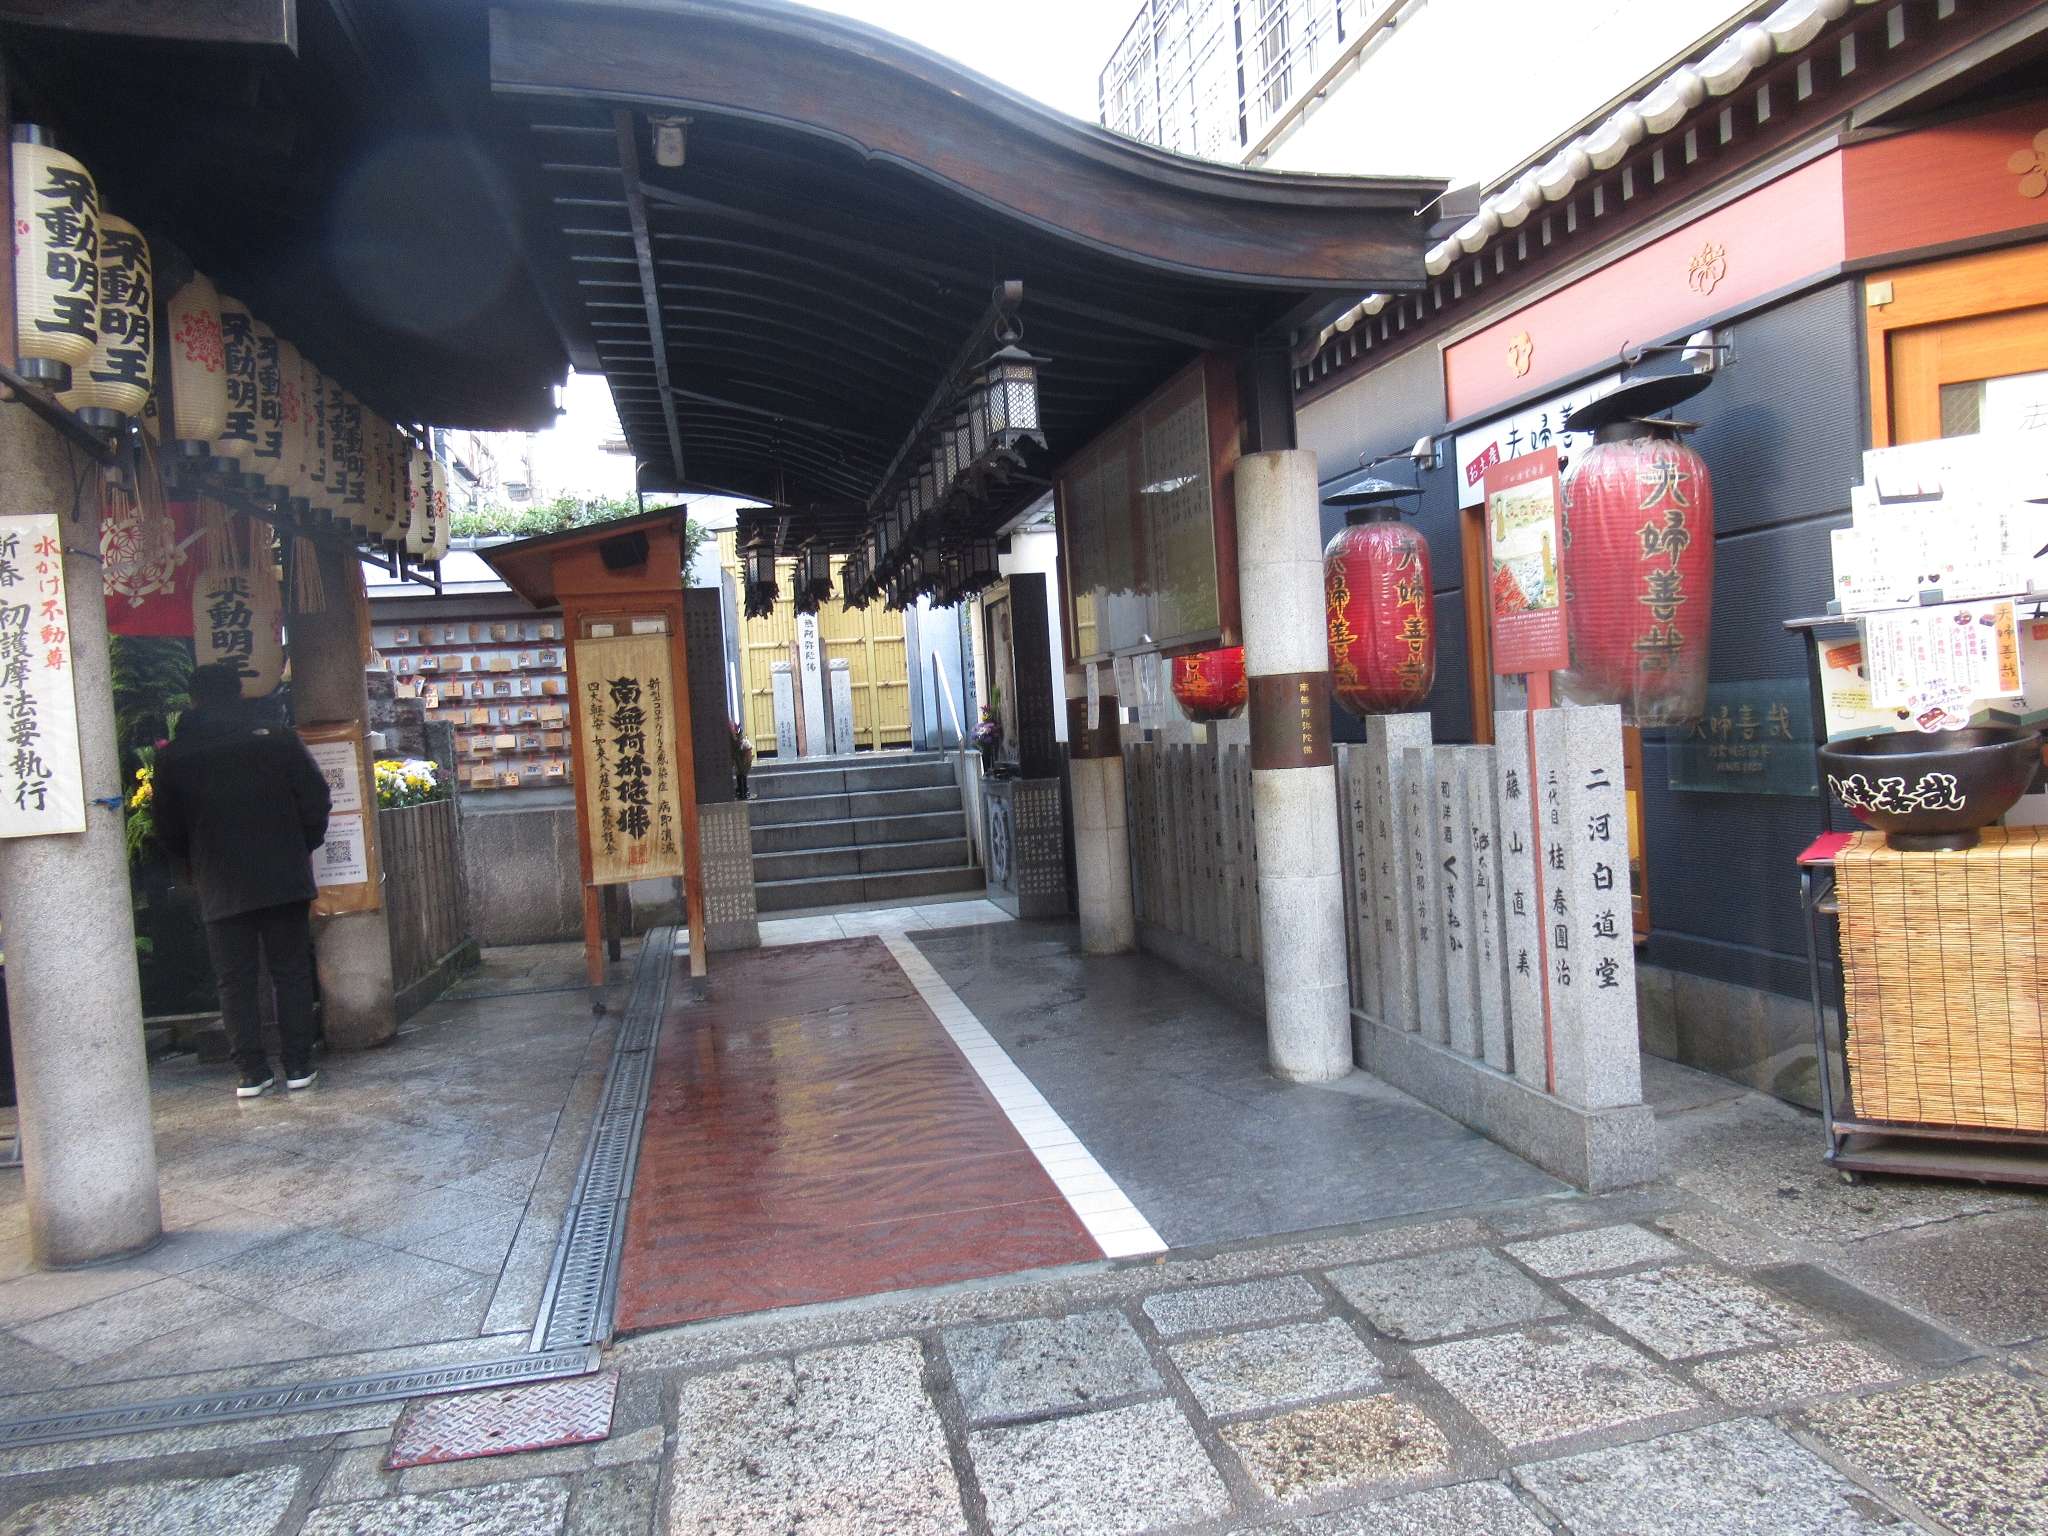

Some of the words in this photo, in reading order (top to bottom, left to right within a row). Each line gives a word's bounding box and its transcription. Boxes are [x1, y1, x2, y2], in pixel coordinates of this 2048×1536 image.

[35, 165, 99, 345] 不動明王
[89, 229, 151, 392] 不動明王
[218, 312, 258, 442] 不動明王
[1506, 391, 1595, 460] 夫婦善
[1468, 446, 1499, 482] お土産
[34, 534, 68, 671] 水かけ不動尊
[1632, 455, 1690, 672] 夫婦善哉
[1548, 770, 1560, 826] 三代目
[1505, 770, 1531, 978] 藤山直美
[1585, 768, 1619, 989] 二河白道堂
